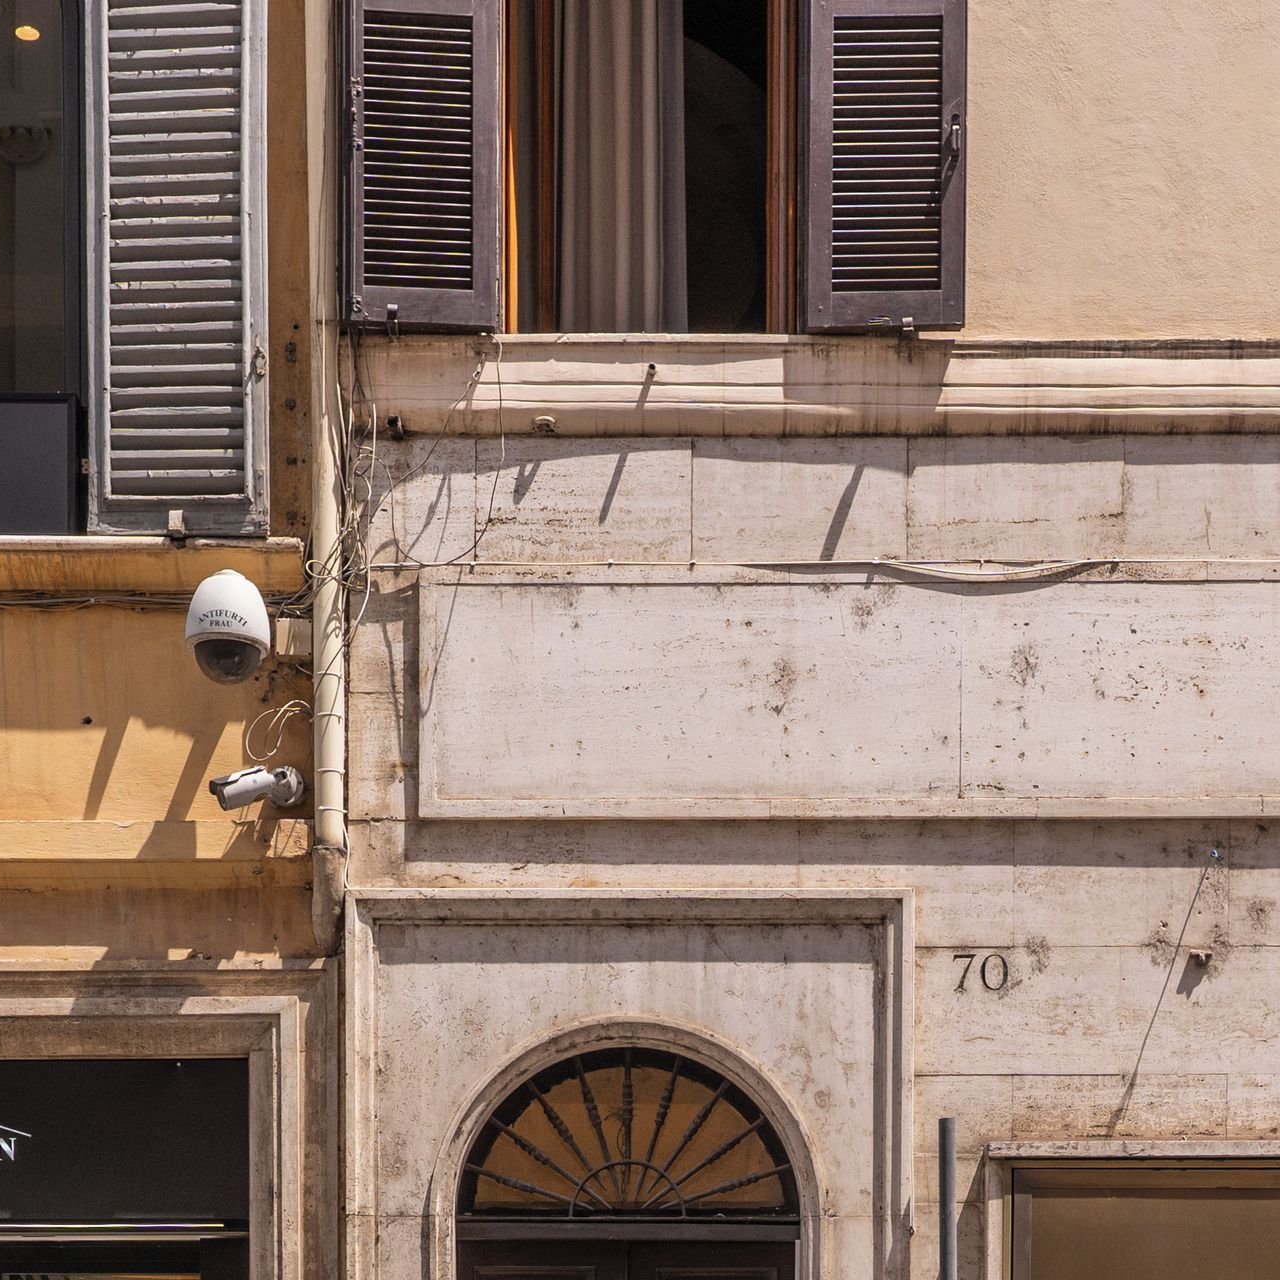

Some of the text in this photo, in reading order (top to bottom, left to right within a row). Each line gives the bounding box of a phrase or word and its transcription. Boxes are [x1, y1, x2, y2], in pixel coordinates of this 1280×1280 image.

[197, 609, 249, 628] ANTIFURTI
[209, 619, 233, 628] FRAU
[952, 953, 1010, 993] 70
